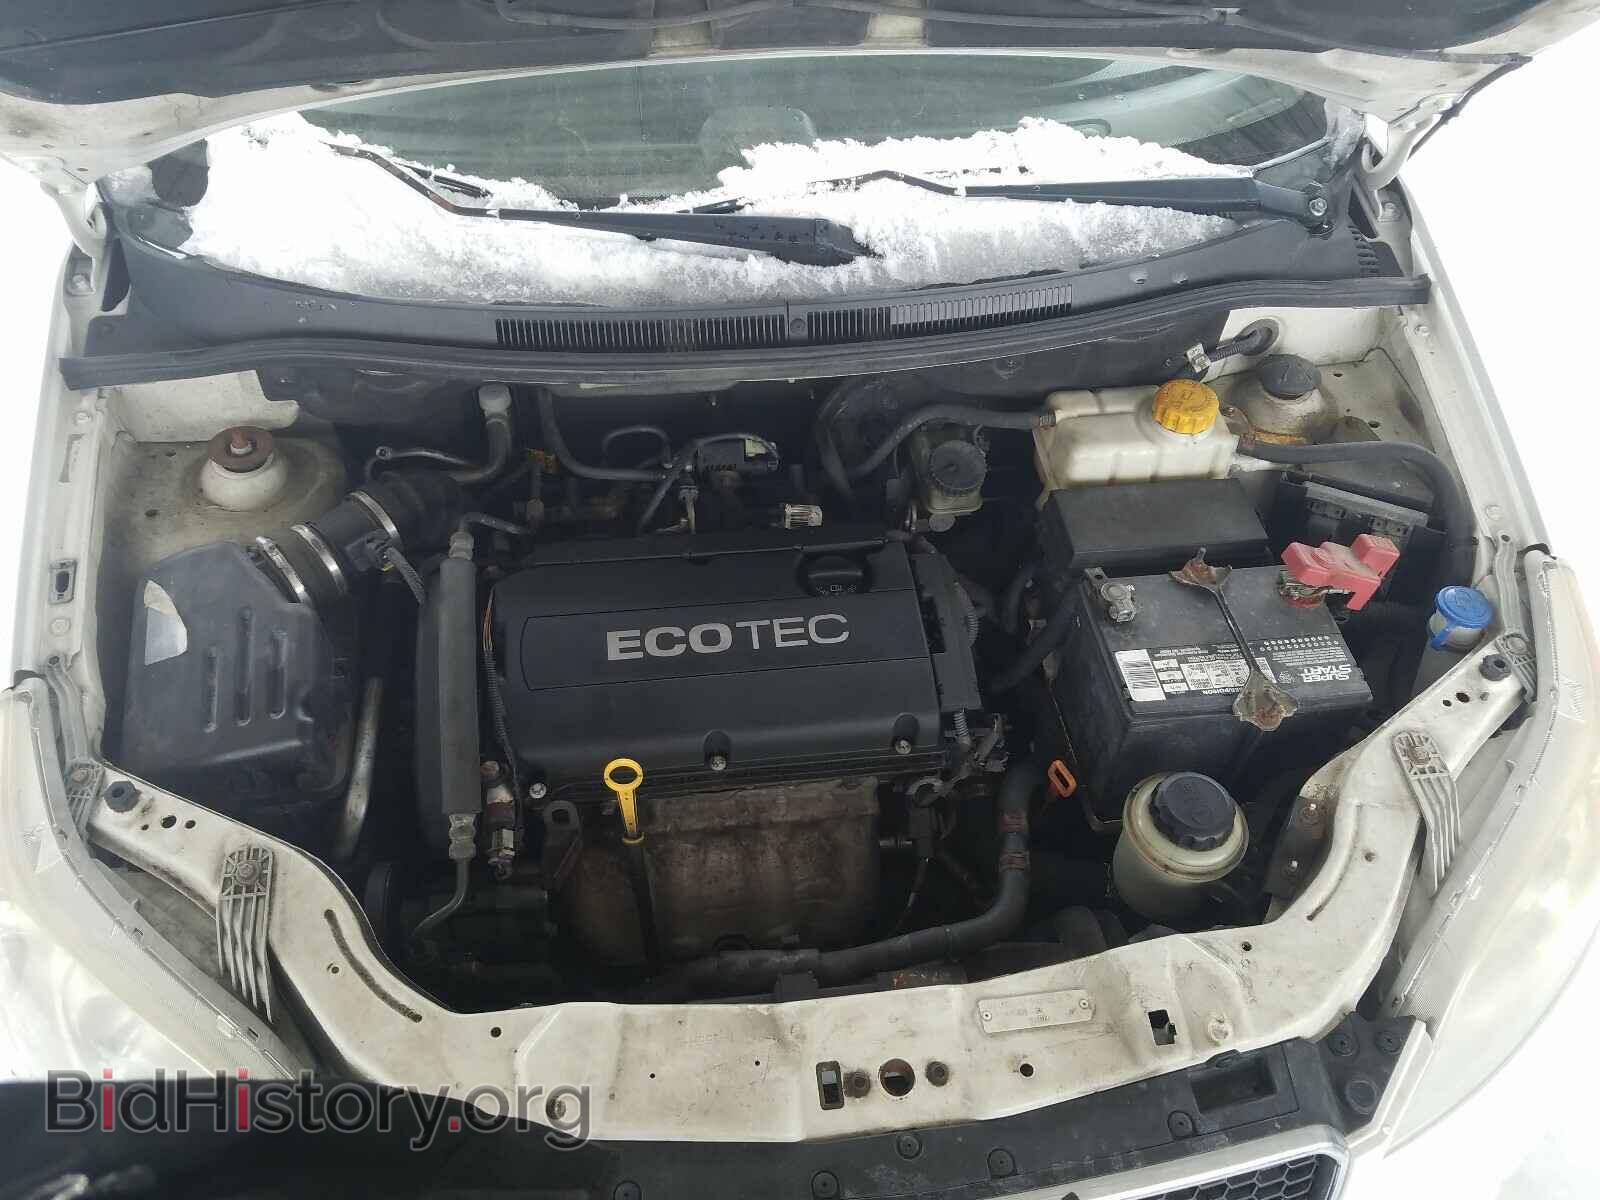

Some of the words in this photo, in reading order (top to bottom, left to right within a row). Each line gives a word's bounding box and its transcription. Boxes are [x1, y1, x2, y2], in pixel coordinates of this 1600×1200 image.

[606, 612, 850, 662] ECOTEC
[1300, 663, 1352, 675] START
[1302, 672, 1350, 683] SUPER
